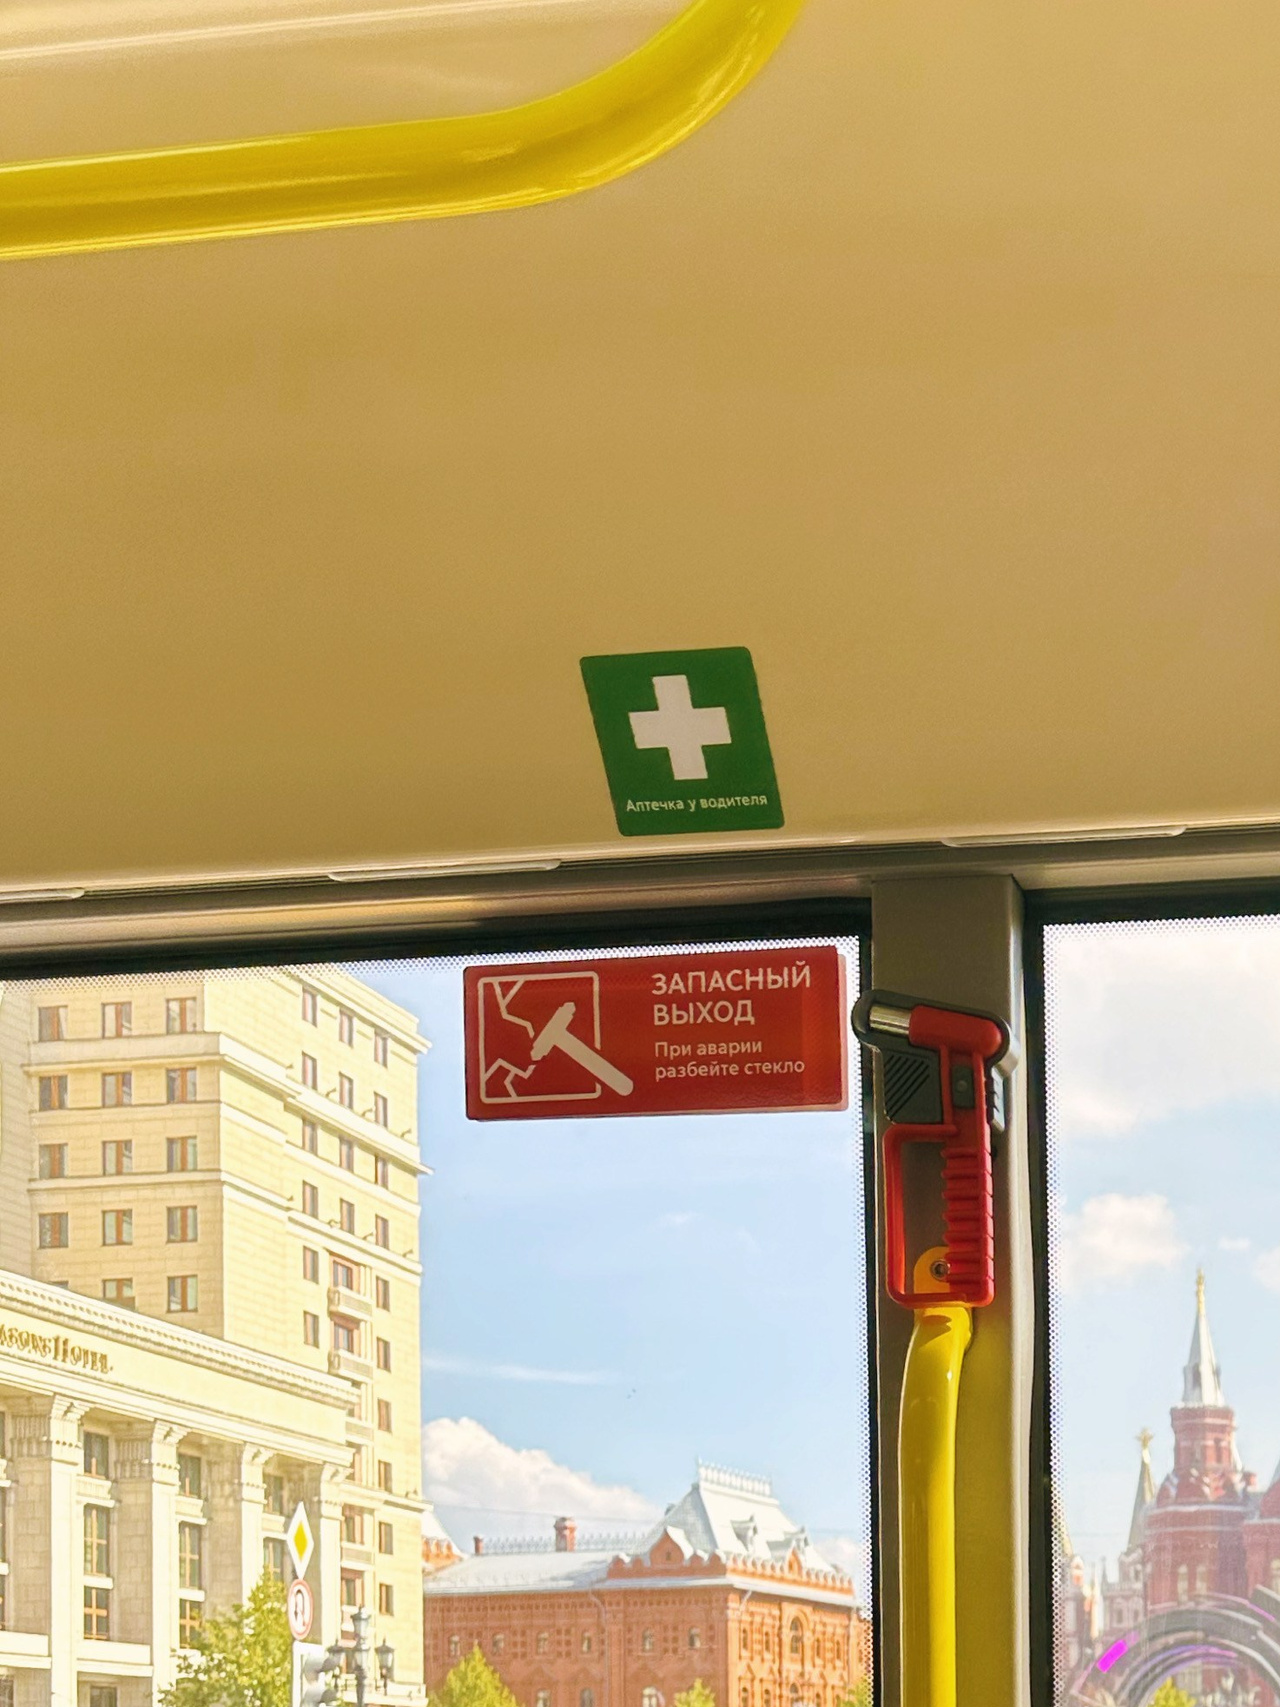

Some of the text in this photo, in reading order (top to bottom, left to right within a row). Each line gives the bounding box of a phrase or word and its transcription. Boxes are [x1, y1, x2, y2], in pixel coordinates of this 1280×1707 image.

[626, 795, 768, 812] Аптечка у водителя
[651, 960, 811, 995] ЗАПАСНЫЙ
[653, 1000, 755, 1026] ВЫХОД
[654, 1040, 762, 1060] При аварии
[655, 1060, 805, 1082] разбейте стекло
